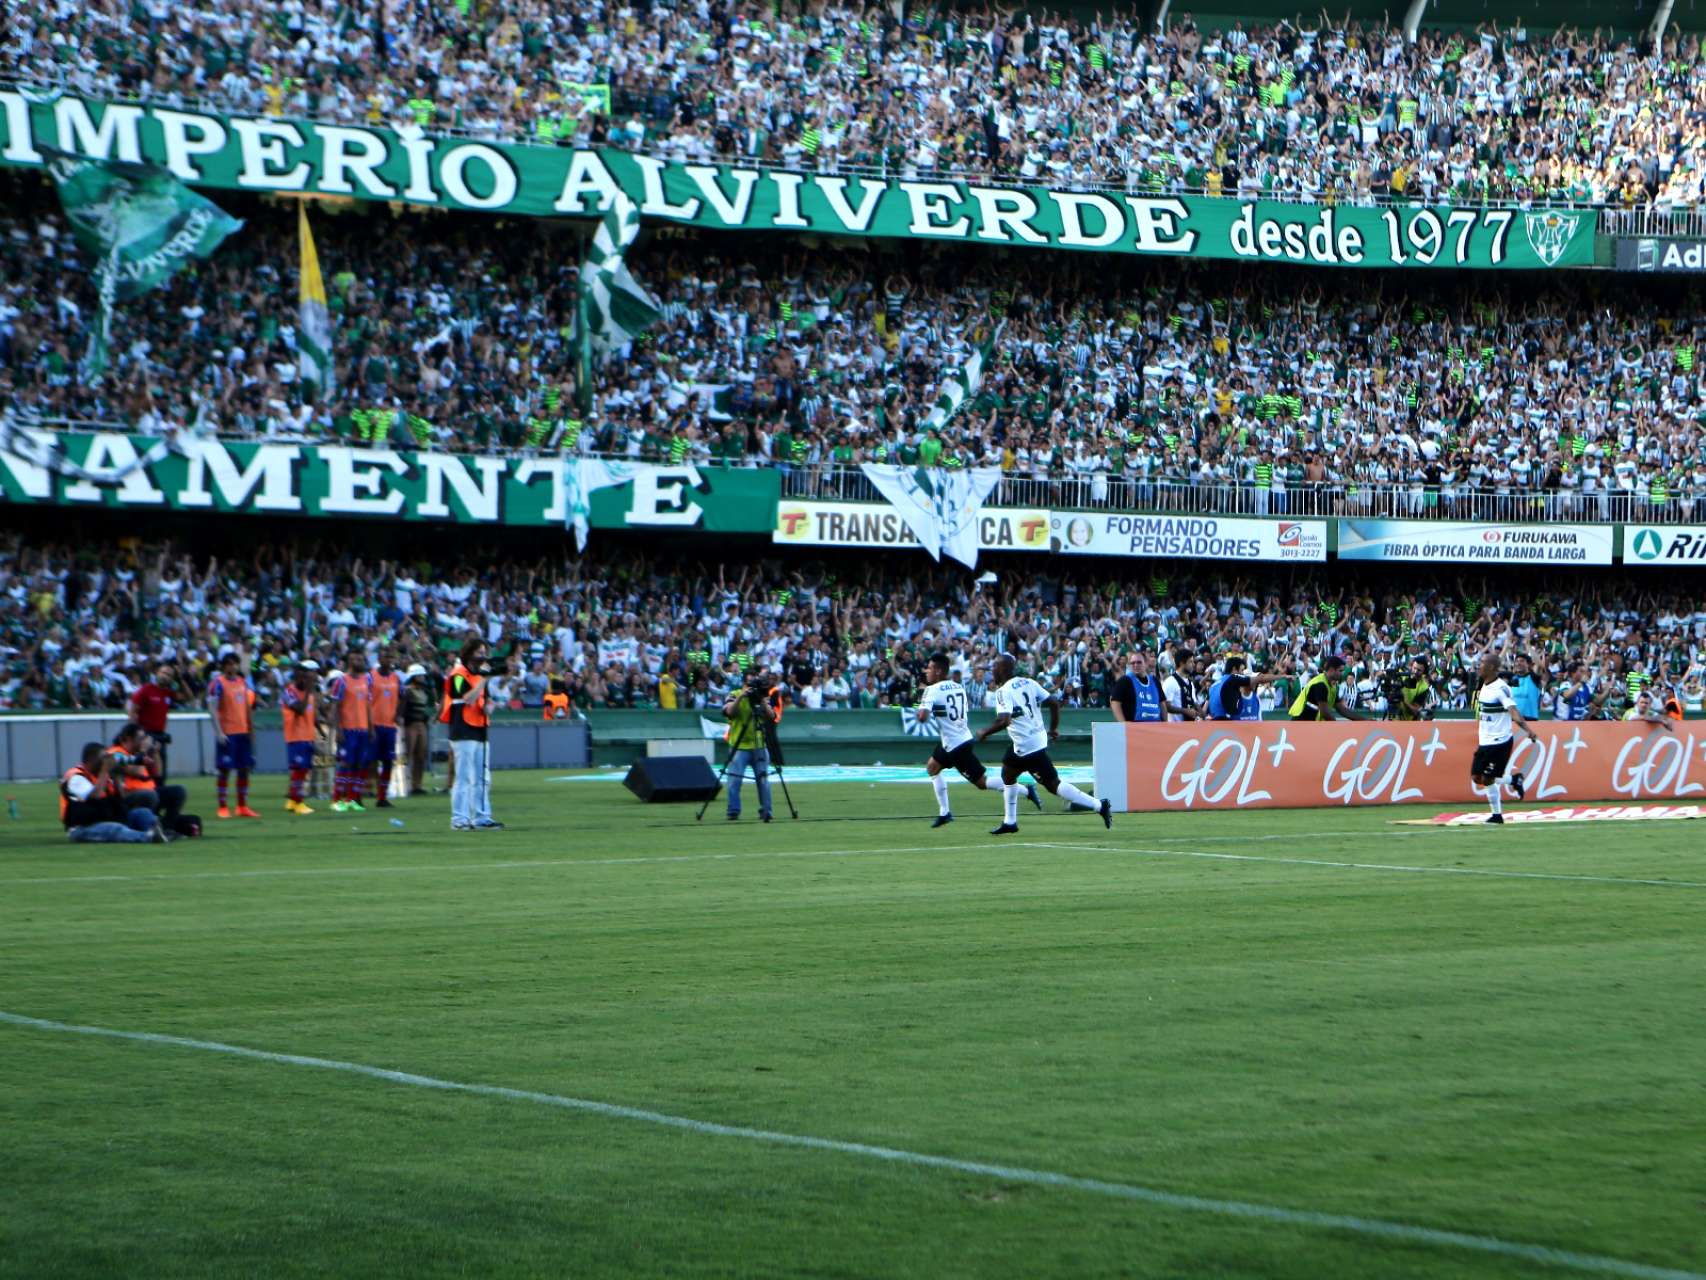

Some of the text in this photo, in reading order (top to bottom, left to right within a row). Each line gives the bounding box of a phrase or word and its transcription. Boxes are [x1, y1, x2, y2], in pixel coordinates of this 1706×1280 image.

[554, 150, 1196, 252] ALVIVERDE
[1230, 204, 1363, 263] desde
[1382, 209, 1513, 265] 1977
[1662, 243, 1706, 269] Ad
[1106, 516, 1218, 538] FORMANDO
[1503, 531, 1578, 545] FURUKAWA
[1130, 536, 1261, 557] PENSADORES
[1384, 544, 1418, 557] FIBRA
[1468, 546, 1500, 559] PARA
[1504, 547, 1544, 559] BANDA
[1547, 547, 1586, 560] LARGA
[946, 692, 965, 722] 37
